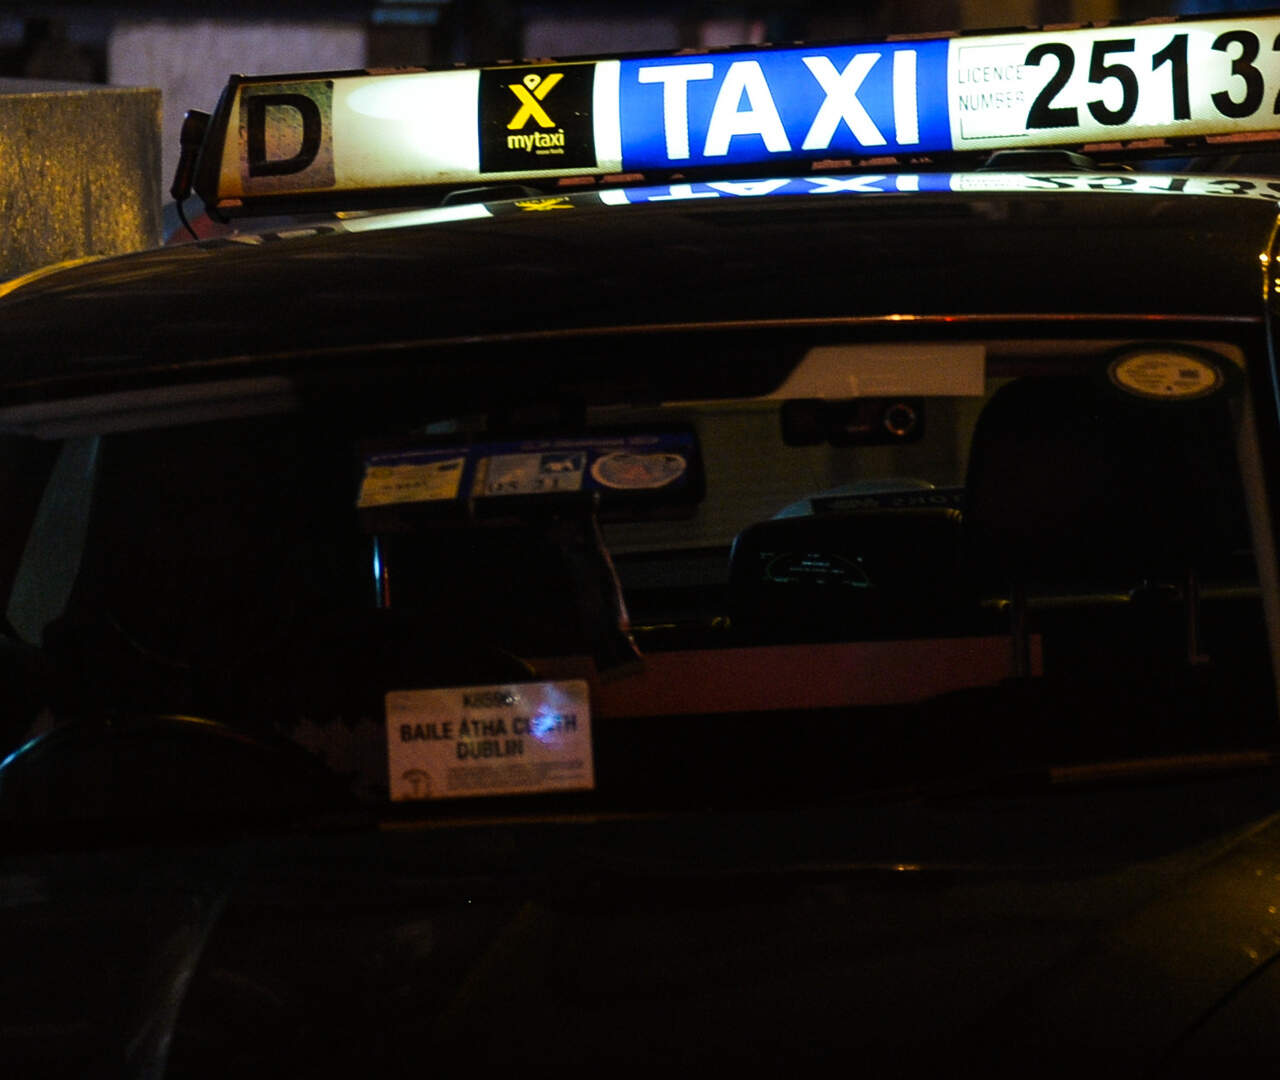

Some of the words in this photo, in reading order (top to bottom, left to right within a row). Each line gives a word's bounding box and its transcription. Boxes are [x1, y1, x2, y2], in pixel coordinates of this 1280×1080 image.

[958, 65, 1023, 84] LICENCE
[638, 49, 918, 159] TAXI
[959, 91, 1024, 110] NUMBER
[247, 93, 321, 178] D
[507, 128, 564, 152] mytaxi
[401, 723, 453, 741] BAILE
[456, 739, 524, 759] DUBLIN
